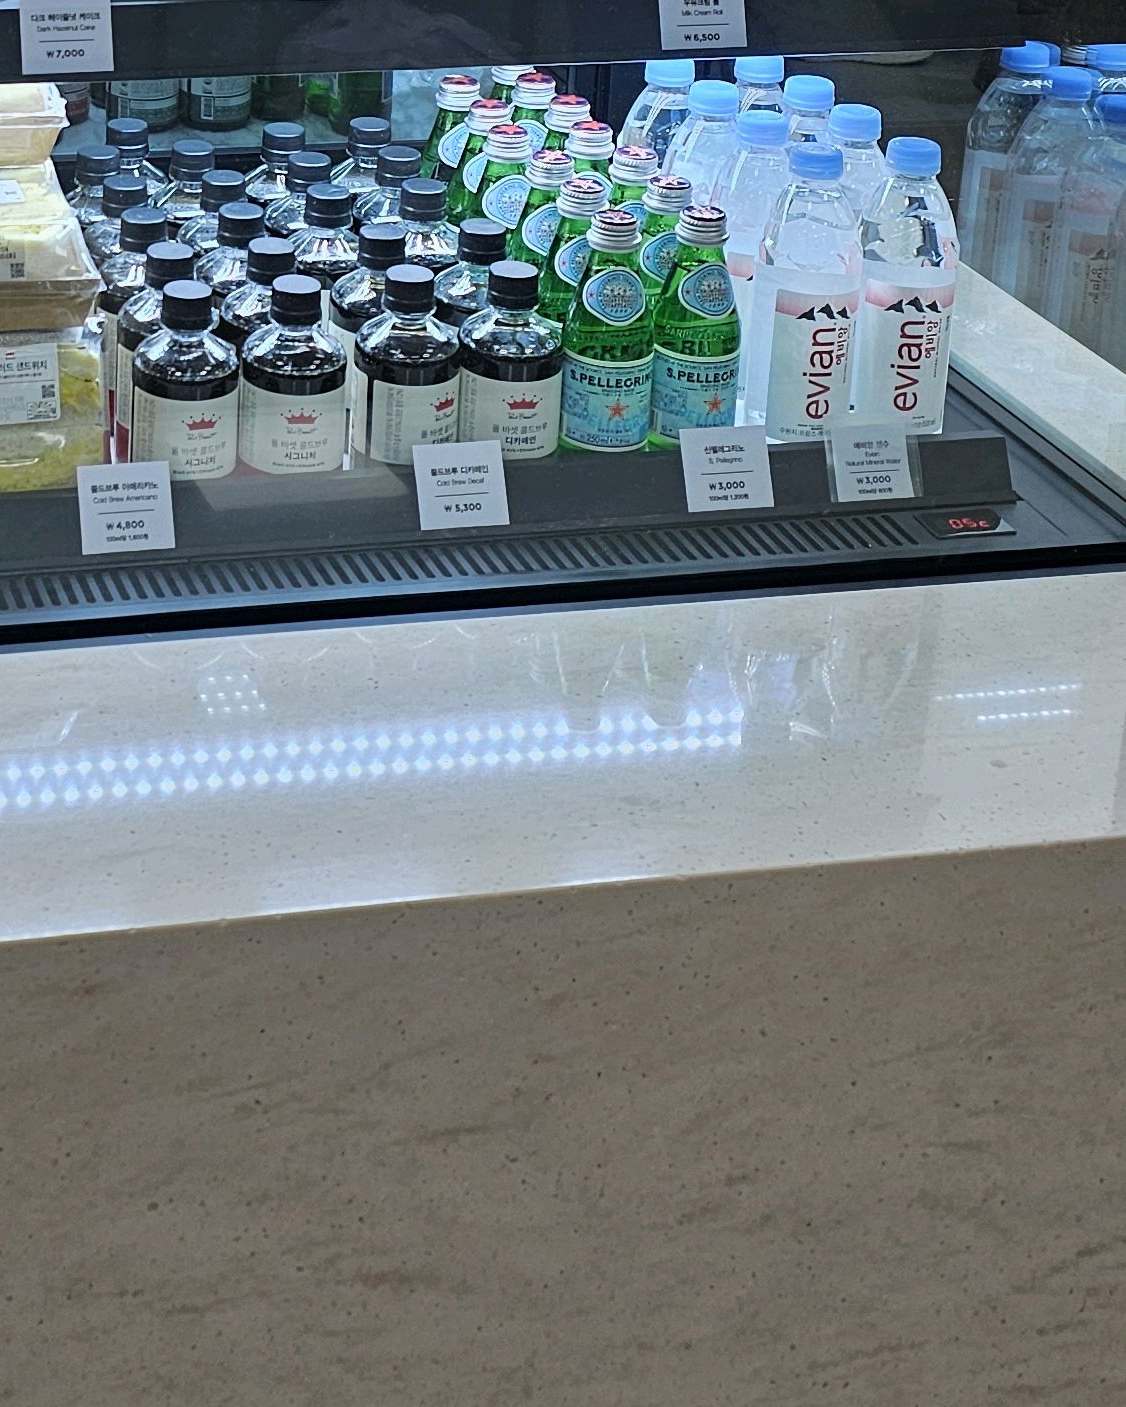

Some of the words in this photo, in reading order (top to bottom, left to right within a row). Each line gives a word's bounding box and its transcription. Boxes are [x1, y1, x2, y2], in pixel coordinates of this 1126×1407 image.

[31, 14, 46, 22] 다크
[694, 33, 720, 43] 6,500
[56, 49, 85, 59] 7,000
[925, 320, 939, 359] 에비앙
[836, 327, 848, 366] 에비앙
[17, 360, 48, 372] 샌드위치
[890, 320, 926, 412] evian
[803, 328, 836, 420] evian
[506, 436, 537, 446] 디카페인
[185, 456, 216, 466] 시그니처
[284, 451, 316, 461] 시그니처
[866, 475, 891, 485] 3,000
[718, 481, 746, 491] 3,000
[455, 503, 482, 513] 5,300
[116, 520, 145, 531] 4,800
